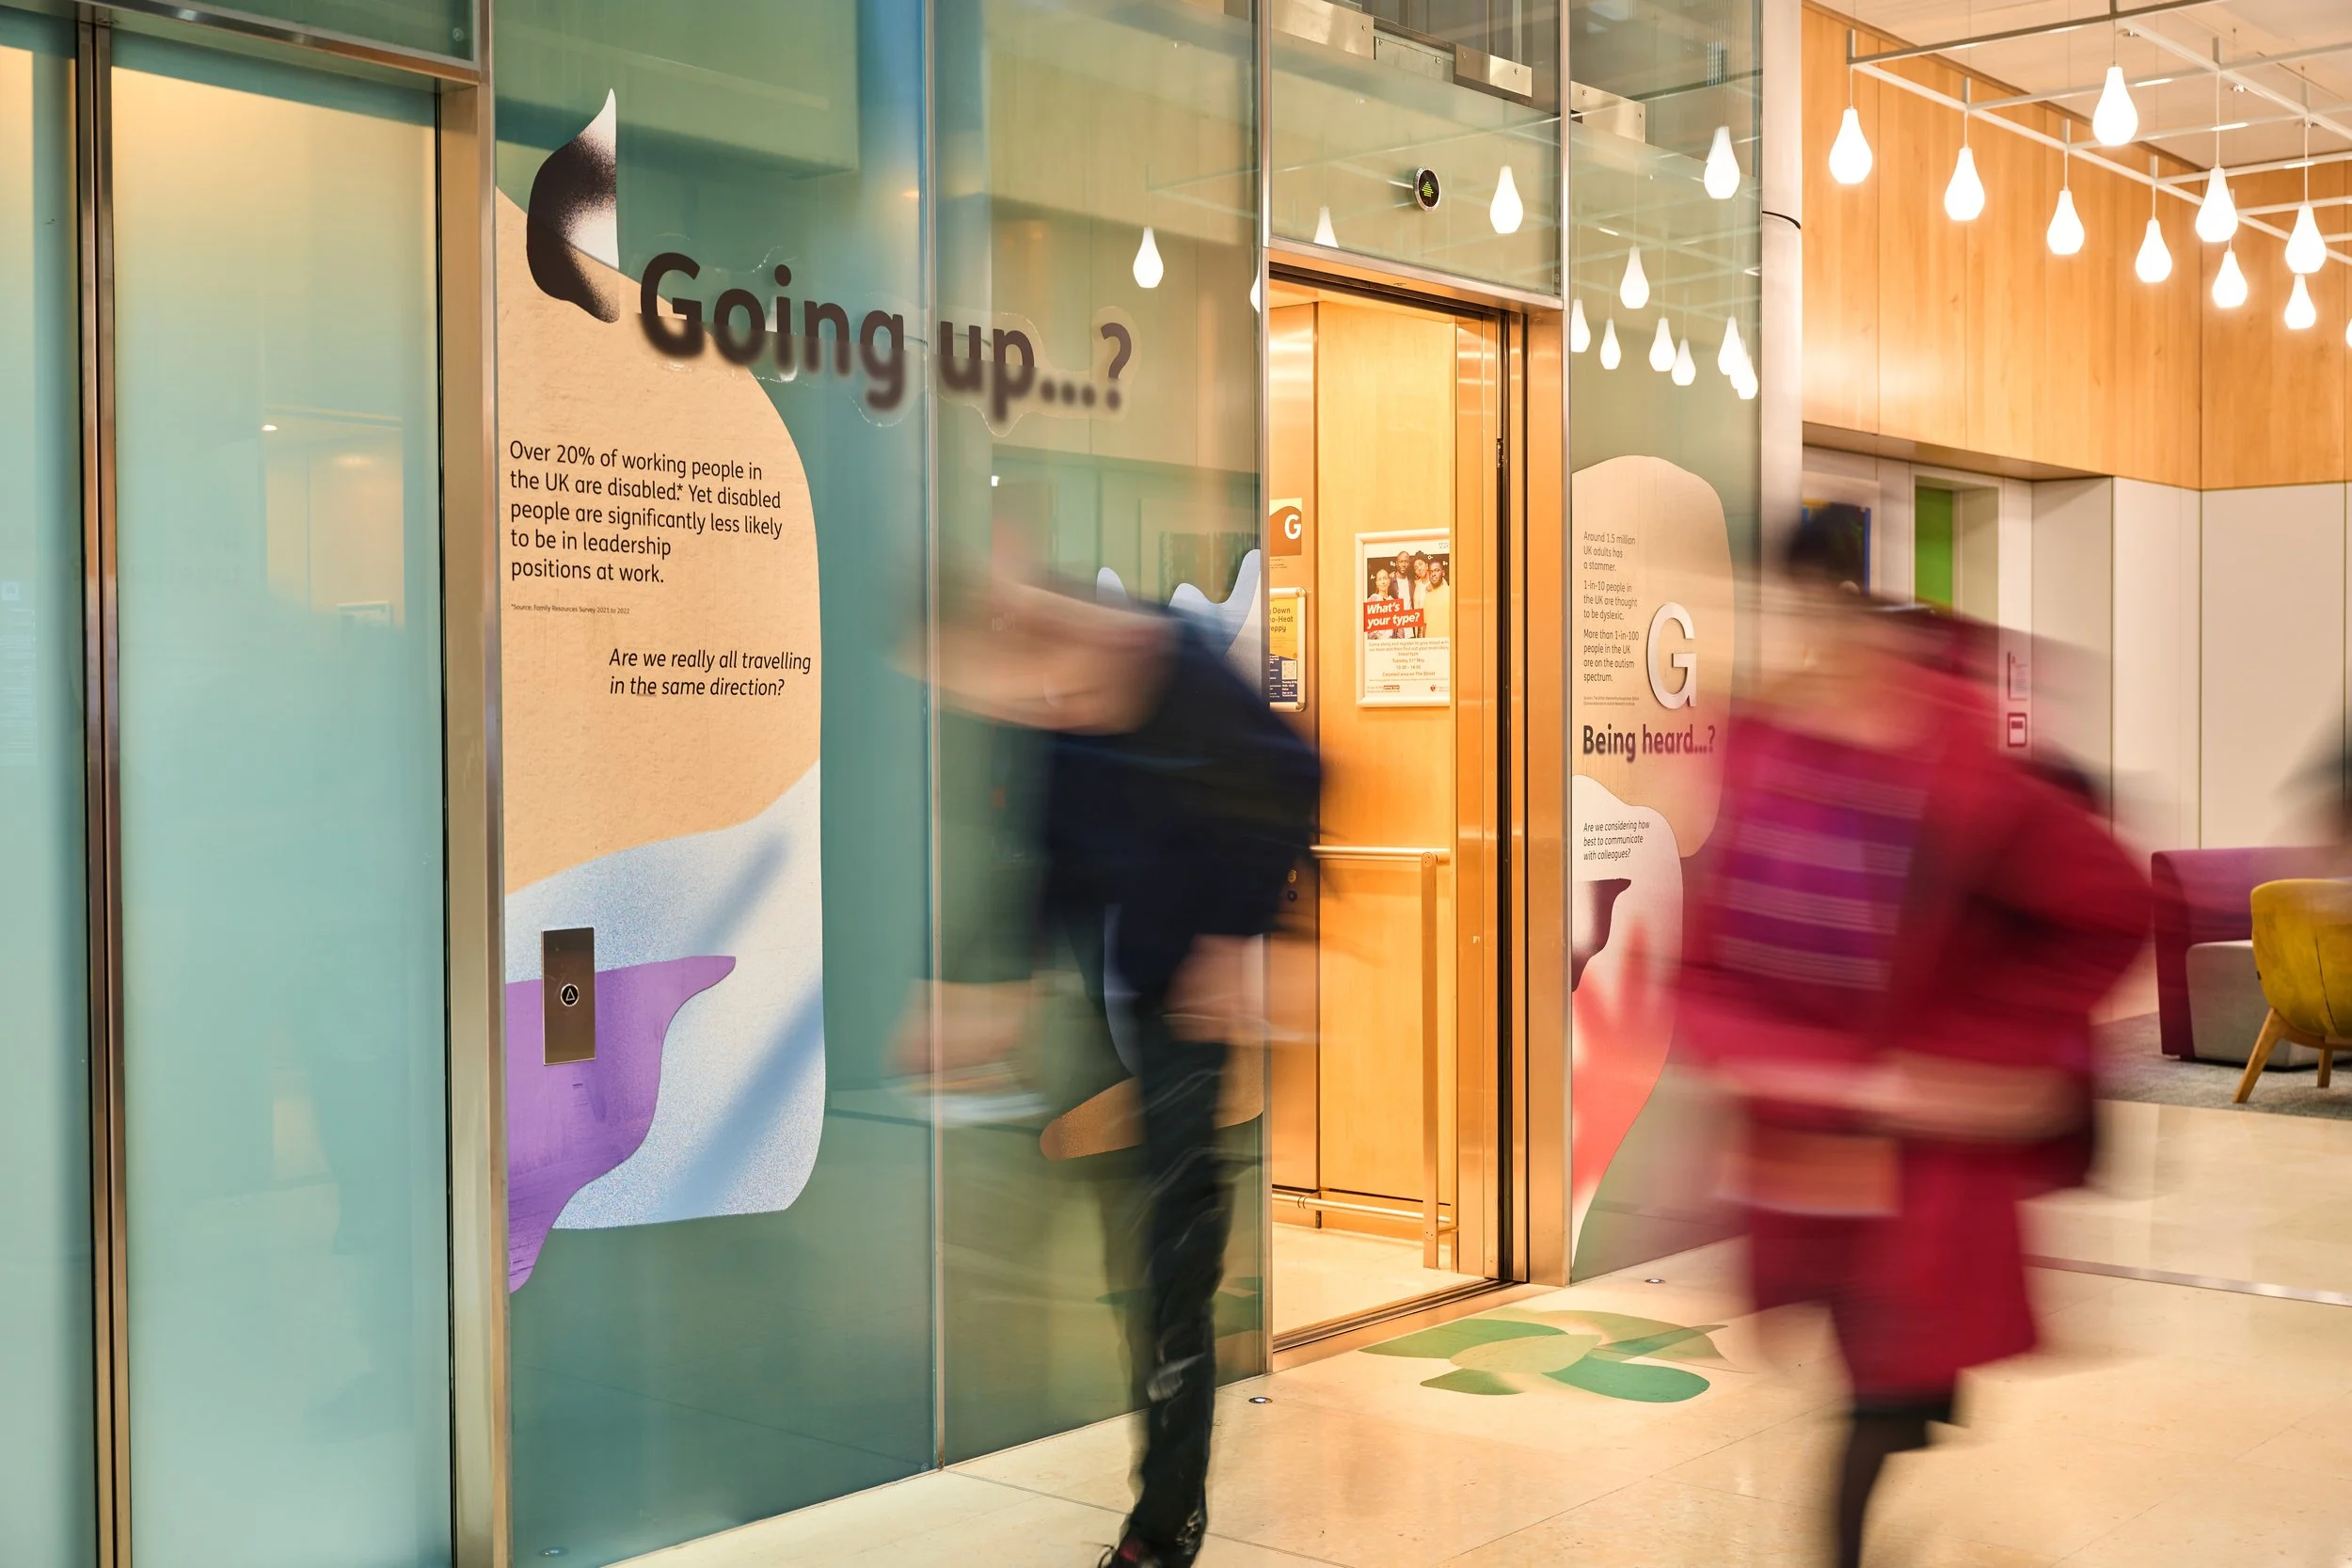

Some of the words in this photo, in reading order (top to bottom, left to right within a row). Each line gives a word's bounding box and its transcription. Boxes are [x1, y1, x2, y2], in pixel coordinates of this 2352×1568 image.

[640, 252, 906, 411] Going
[510, 440, 550, 461] Over
[557, 444, 595, 466] 20%
[600, 449, 618, 467] of
[622, 452, 686, 479] working
[691, 460, 744, 482] people
[749, 462, 762, 480] in
[510, 469, 539, 490] the
[546, 472, 569, 492] UK
[575, 479, 602, 495] are
[688, 483, 713, 503] Yet
[718, 486, 781, 509] disabled
[511, 501, 570, 525] people
[576, 508, 603, 523] are
[608, 506, 706, 535] significantly
[710, 513, 739, 532] less
[744, 515, 783, 540] likely
[1284, 514, 1302, 540] G
[511, 529, 529, 547] to
[535, 529, 556, 549] be
[562, 531, 578, 550] in
[583, 531, 672, 561] leadership
[1583, 531, 1605, 543] Around
[1606, 532, 1615, 544] 1.5
[1616, 534, 1636, 545] million
[1583, 546, 1593, 555] UK
[1593, 546, 1612, 557] adults
[1613, 549, 1623, 558] has
[511, 559, 592, 581] positions
[596, 564, 614, 580] at
[619, 564, 664, 583] work.
[1583, 562, 1588, 570] a
[1588, 562, 1617, 572] stammer.
[1583, 579, 1605, 591] 1-in-10
[1606, 581, 1626, 593] people
[1627, 582, 1632, 593] in
[1583, 594, 1594, 605] the
[1595, 594, 1603, 605] UK
[1604, 597, 1614, 606] are
[1614, 596, 1637, 608] thought
[1367, 603, 1400, 615] What's
[1583, 610, 1590, 619] to
[1591, 610, 1599, 619] be
[1599, 610, 1625, 622] dyslexic.
[1367, 617, 1390, 629] your
[1392, 612, 1421, 626] type?
[1583, 629, 1598, 639] More
[1599, 630, 1613, 640] than
[1614, 630, 1640, 641] 1-in-100
[1583, 644, 1603, 656] people
[1604, 644, 1611, 654] in
[1612, 644, 1622, 655] the
[1622, 645, 1631, 655] UK
[1646, 601, 1697, 709] G
[609, 648, 638, 667] Are
[643, 653, 666, 668] we
[671, 649, 715, 673] really
[719, 650, 738, 670] all
[741, 651, 811, 674] travelling
[1595, 659, 1602, 668] on
[1603, 658, 1613, 668] the
[1614, 659, 1634, 669] autism
[610, 676, 625, 694] in
[630, 675, 658, 695] the
[661, 680, 706, 695] same
[709, 676, 786, 696] direction?
[1583, 673, 1613, 684] spectrum.
[1582, 723, 1636, 764] Being
[1583, 822, 1594, 832] Are
[1604, 820, 1637, 832] considering
[1638, 820, 1650, 829] how
[1583, 836, 1597, 847] best
[1597, 836, 1604, 846] to
[1604, 834, 1644, 845] communicate
[1583, 850, 1597, 861] with
[1597, 848, 1631, 861] colleagues?
